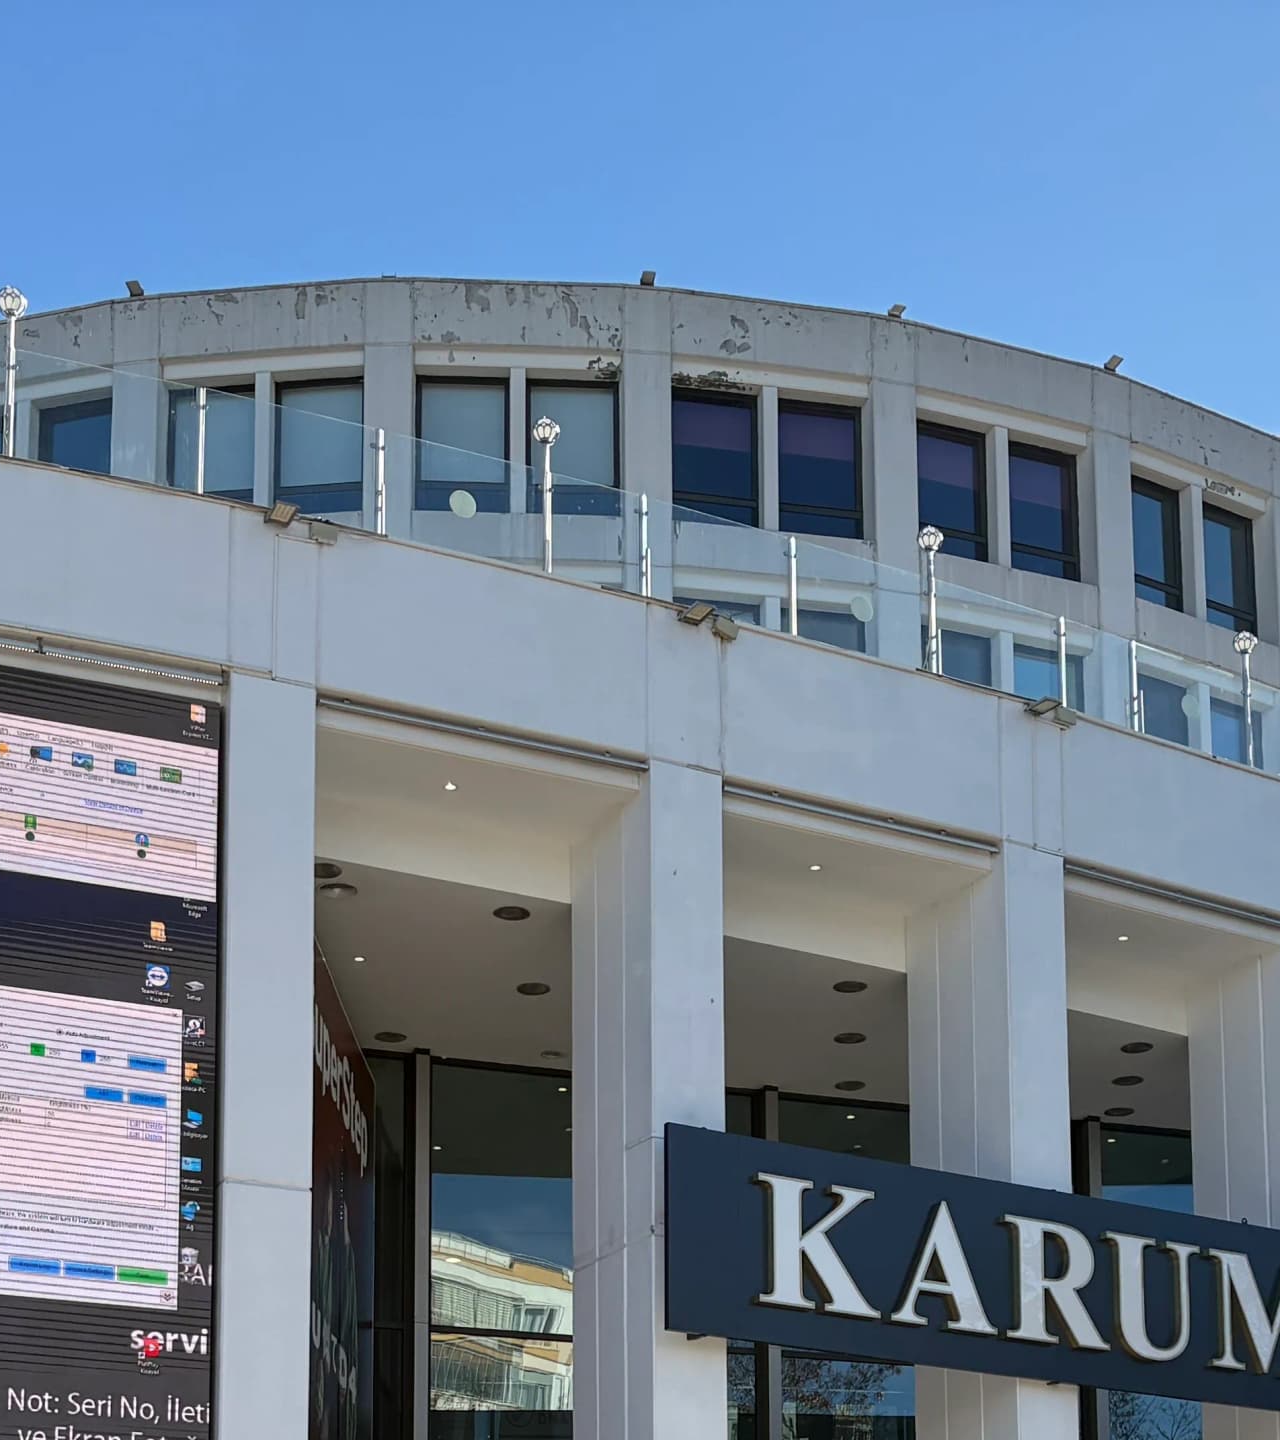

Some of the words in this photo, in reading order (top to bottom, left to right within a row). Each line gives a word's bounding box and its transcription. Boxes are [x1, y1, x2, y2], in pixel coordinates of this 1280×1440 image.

[7, 1387, 59, 1413] Not:
[67, 1392, 111, 1417] Seri
[120, 1396, 160, 1424] No,
